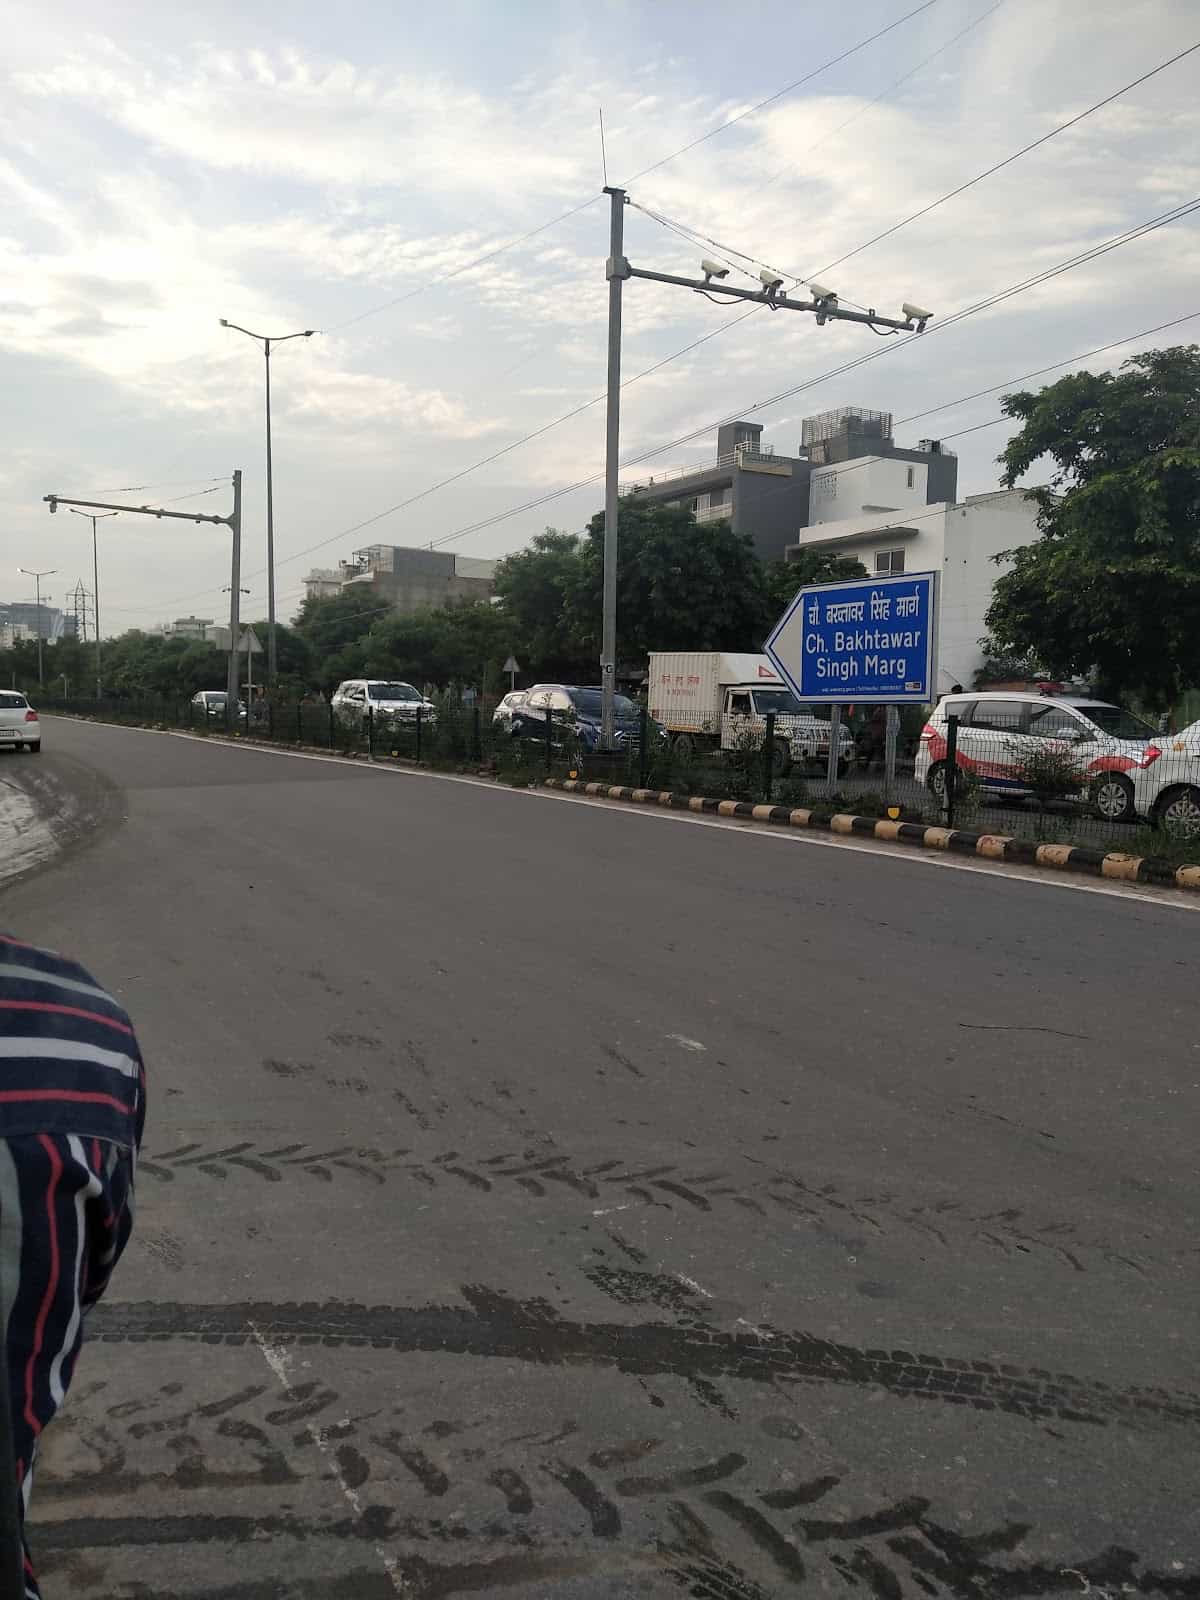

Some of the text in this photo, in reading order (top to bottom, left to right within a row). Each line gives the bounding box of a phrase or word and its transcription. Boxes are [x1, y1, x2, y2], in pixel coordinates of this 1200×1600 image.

[870, 591, 891, 620] सिंह
[896, 586, 919, 617] मार्ग
[806, 630, 921, 654] Ch. Bakhtawar
[816, 655, 906, 680] Singh Marg
